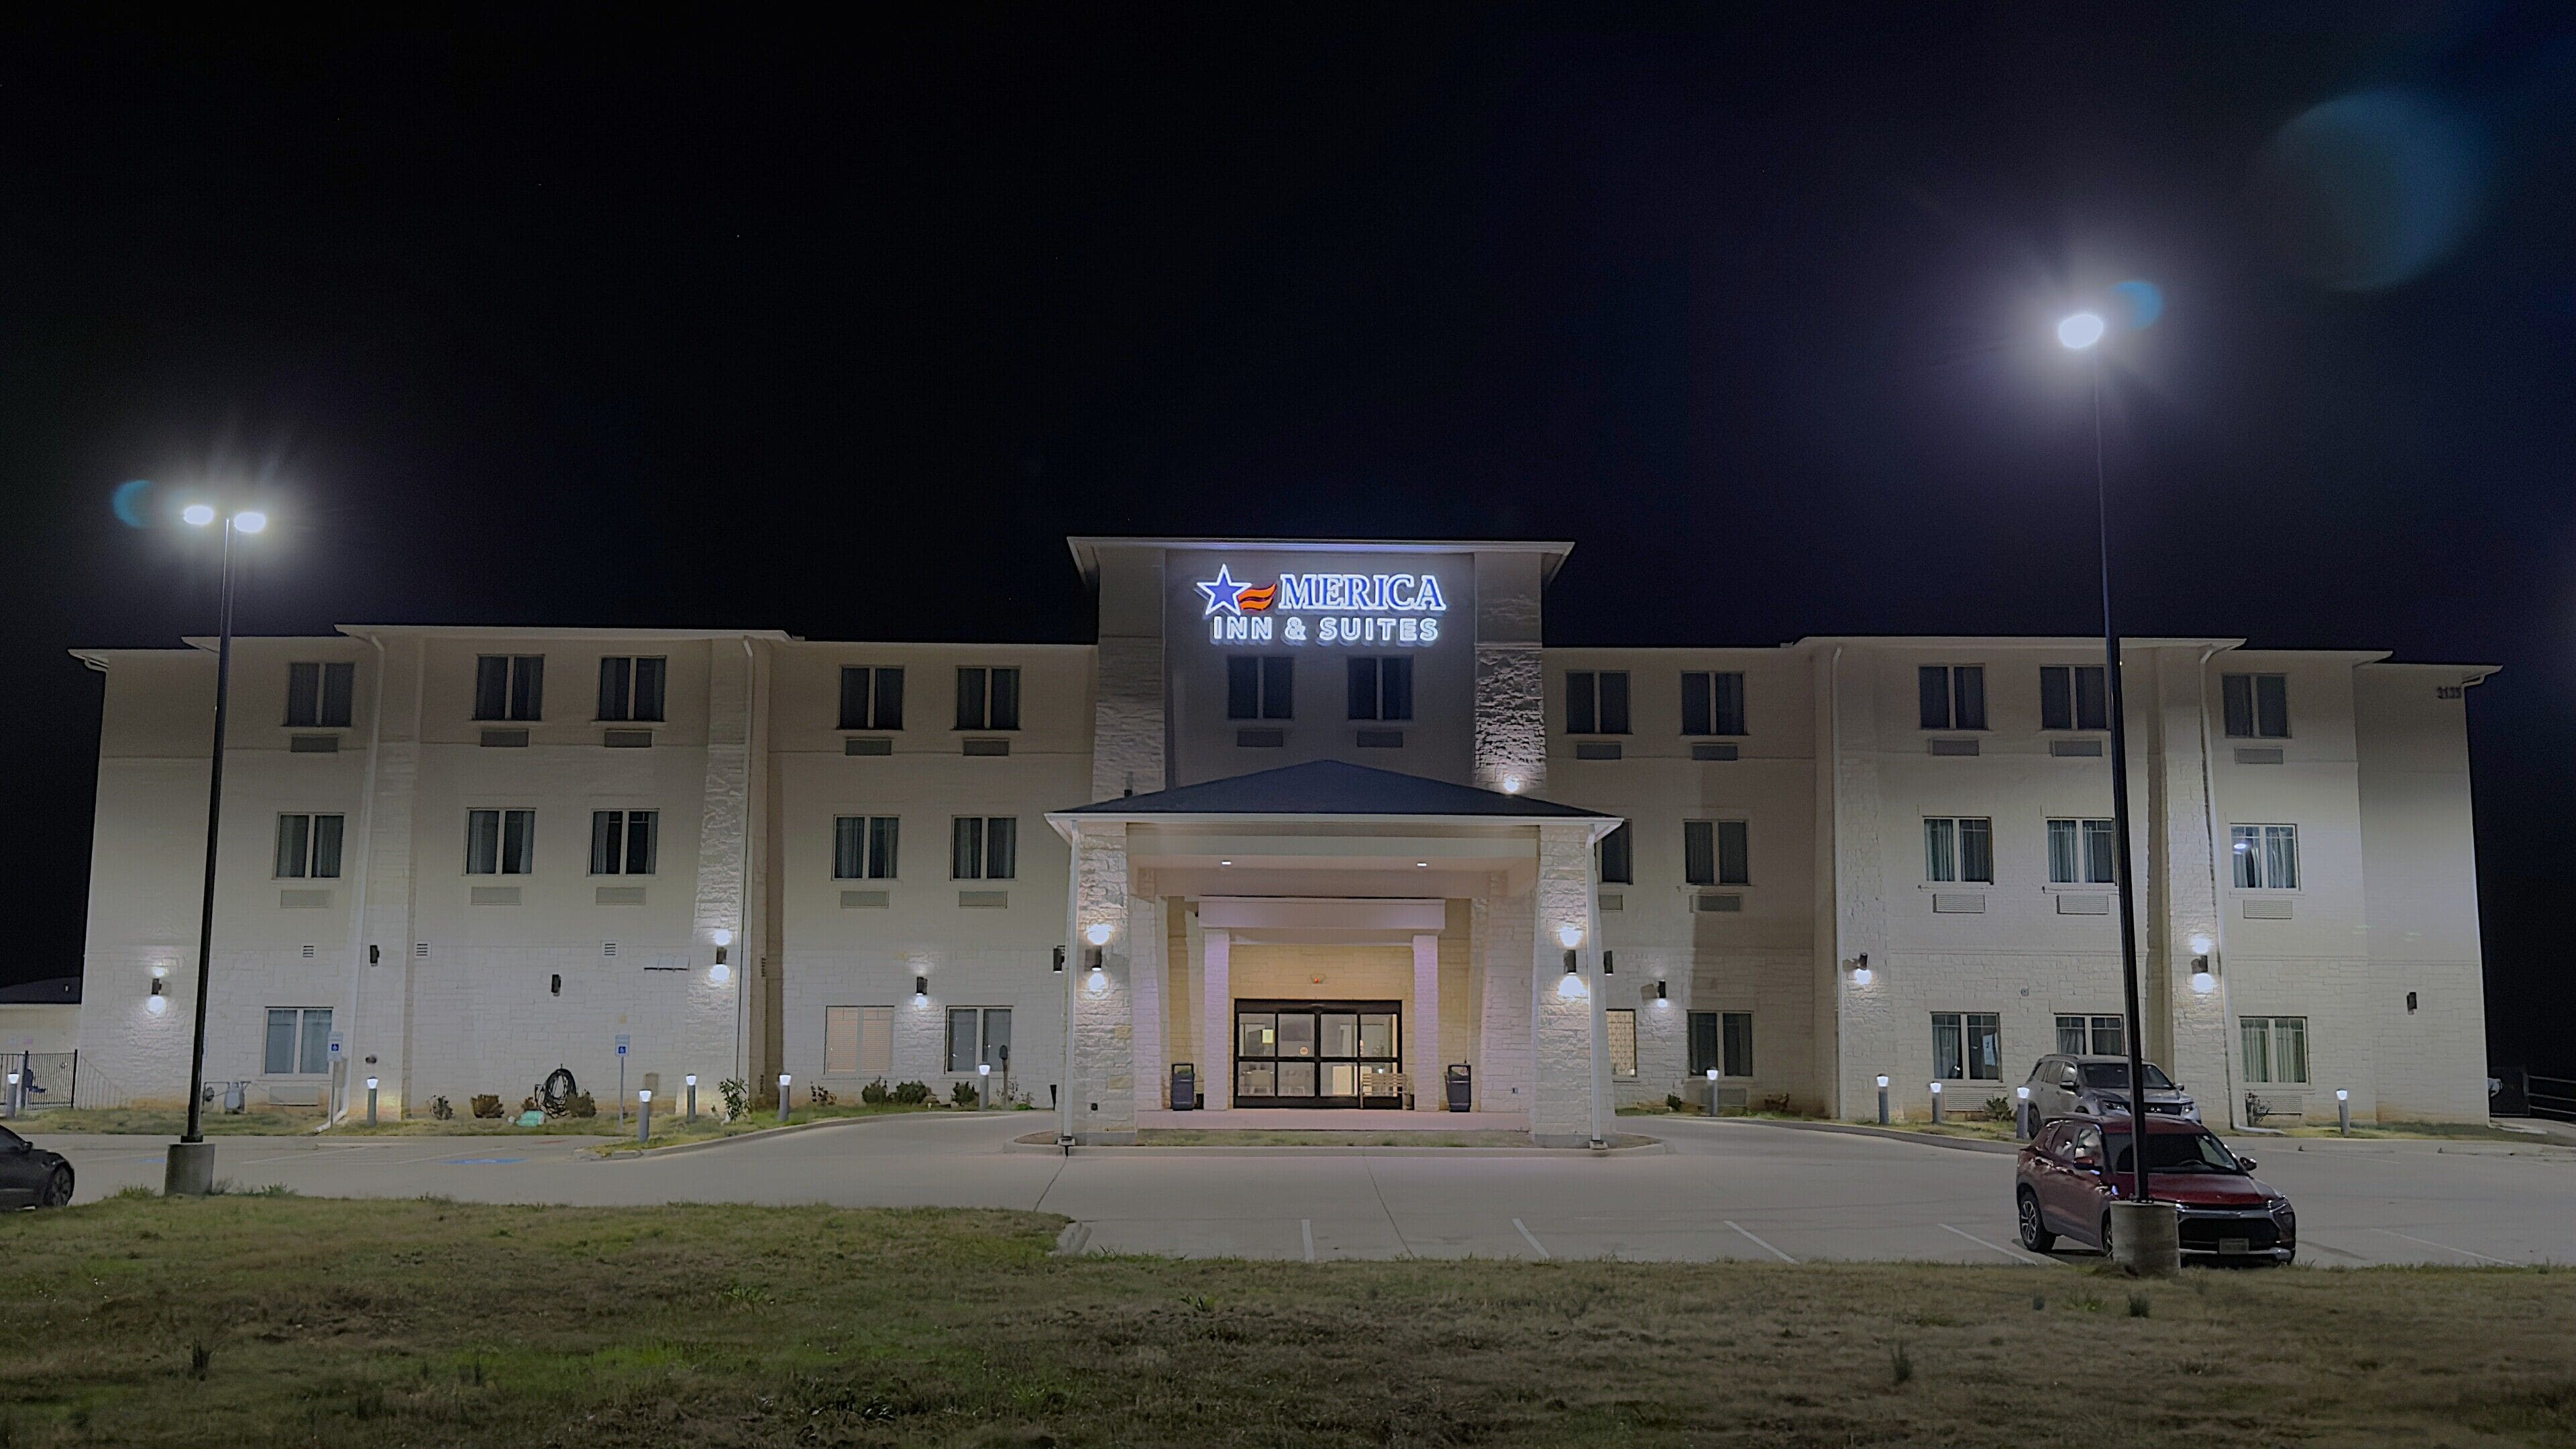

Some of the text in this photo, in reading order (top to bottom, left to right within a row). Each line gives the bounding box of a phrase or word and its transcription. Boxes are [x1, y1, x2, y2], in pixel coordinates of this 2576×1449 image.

[1214, 616, 1438, 641] INN & SUITES
